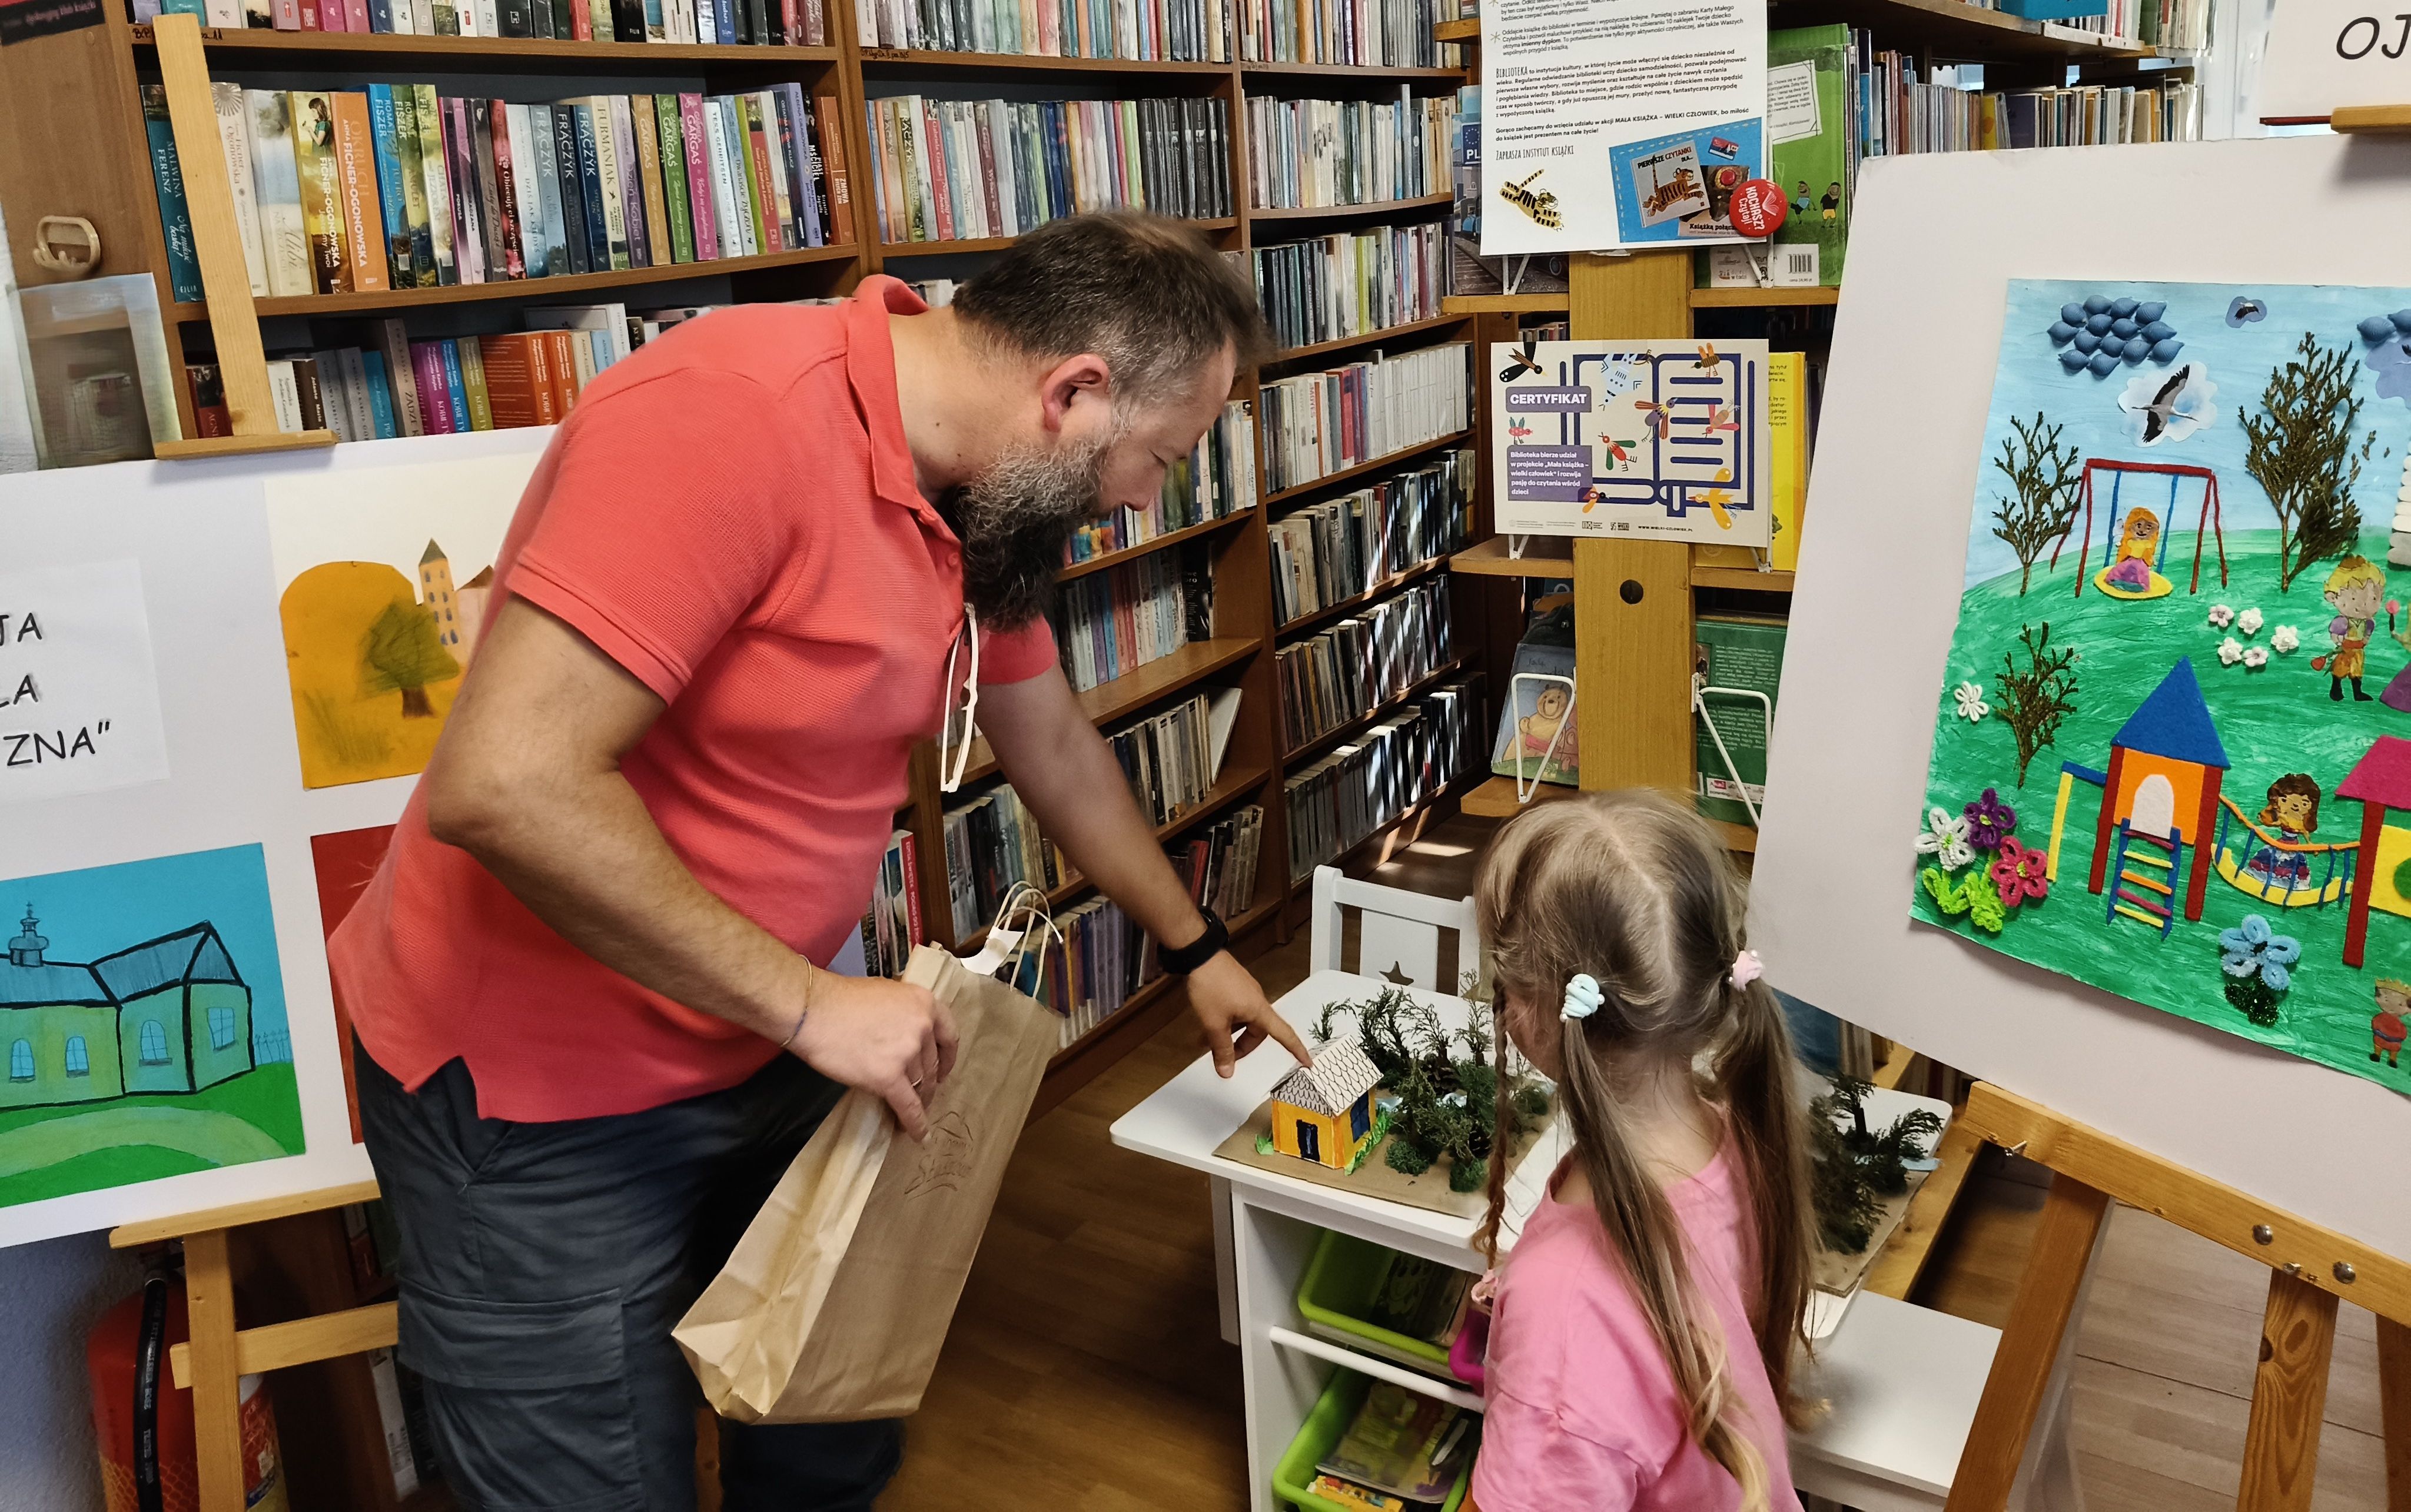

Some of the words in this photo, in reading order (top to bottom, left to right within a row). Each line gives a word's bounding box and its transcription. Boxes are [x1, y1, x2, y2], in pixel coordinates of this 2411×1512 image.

[1496, 66, 1527, 78] BIBLIOTEKA
[1639, 62, 1682, 71] samodzielności,
[1709, 57, 1746, 67] podejmować
[375, 99, 387, 137] FISZER
[395, 101, 407, 141] FISZER
[686, 115, 701, 165] GARGAŚ
[536, 112, 553, 177] FRĄCZYK
[558, 114, 574, 178] FRĄCZYK
[579, 112, 596, 176] FRĄCZYK
[597, 108, 616, 185] FURMANIAK
[640, 118, 654, 169] GARGAŚ
[662, 117, 678, 167] GARGAŚ
[1466, 149, 1480, 159] PL
[1665, 147, 1692, 160] CZYTANKI
[157, 149, 171, 193] FERENZ
[839, 178, 848, 204] ZMOWA
[320, 157, 340, 268] FICNER-OGONOWSKA
[344, 142, 367, 268] FICNER-OGONOWSKA
[1738, 198, 1751, 225] Czytaj!
[1746, 186, 1765, 230] KOCHASZ?
[1510, 394, 1587, 404] CERTYFIKAT
[0, 674, 38, 706] A
